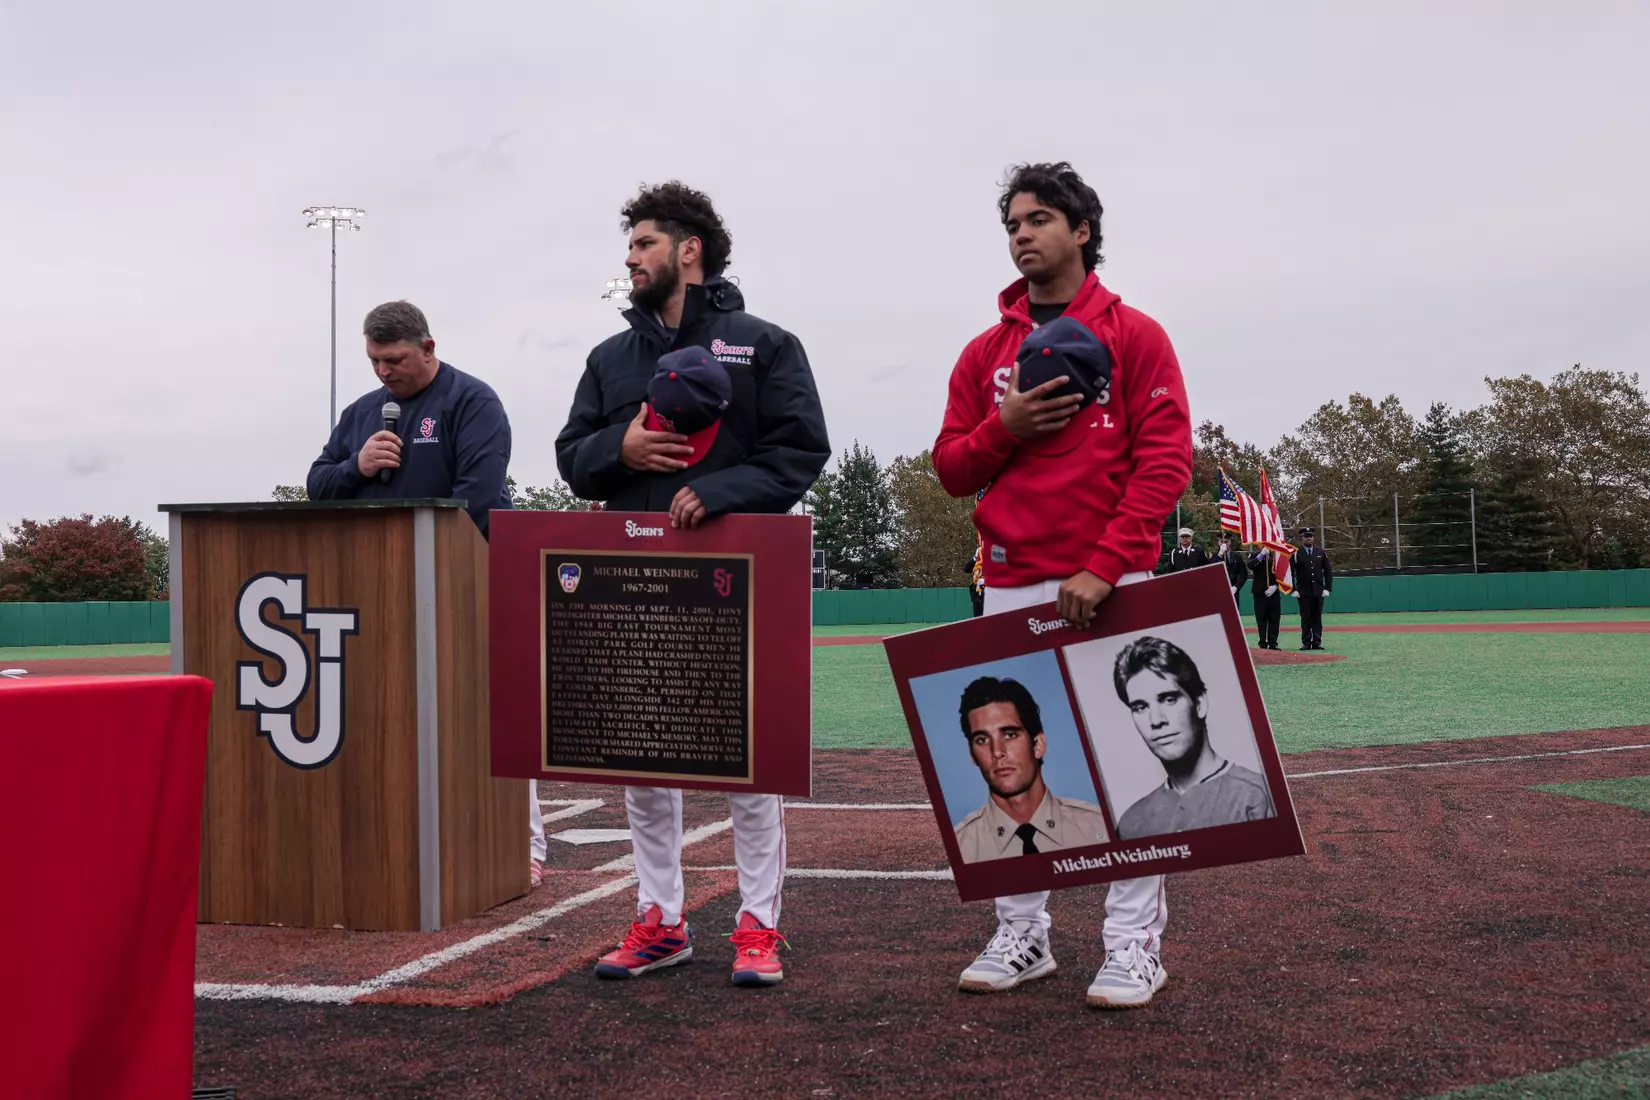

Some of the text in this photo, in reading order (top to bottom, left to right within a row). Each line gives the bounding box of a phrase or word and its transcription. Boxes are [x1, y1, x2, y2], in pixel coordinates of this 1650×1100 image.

[713, 355, 752, 365] ASEBALL
[593, 567, 698, 578] MICHAEL WEINBERG
[622, 583, 669, 593] 1967-2001
[1052, 851, 1113, 875] Michael
